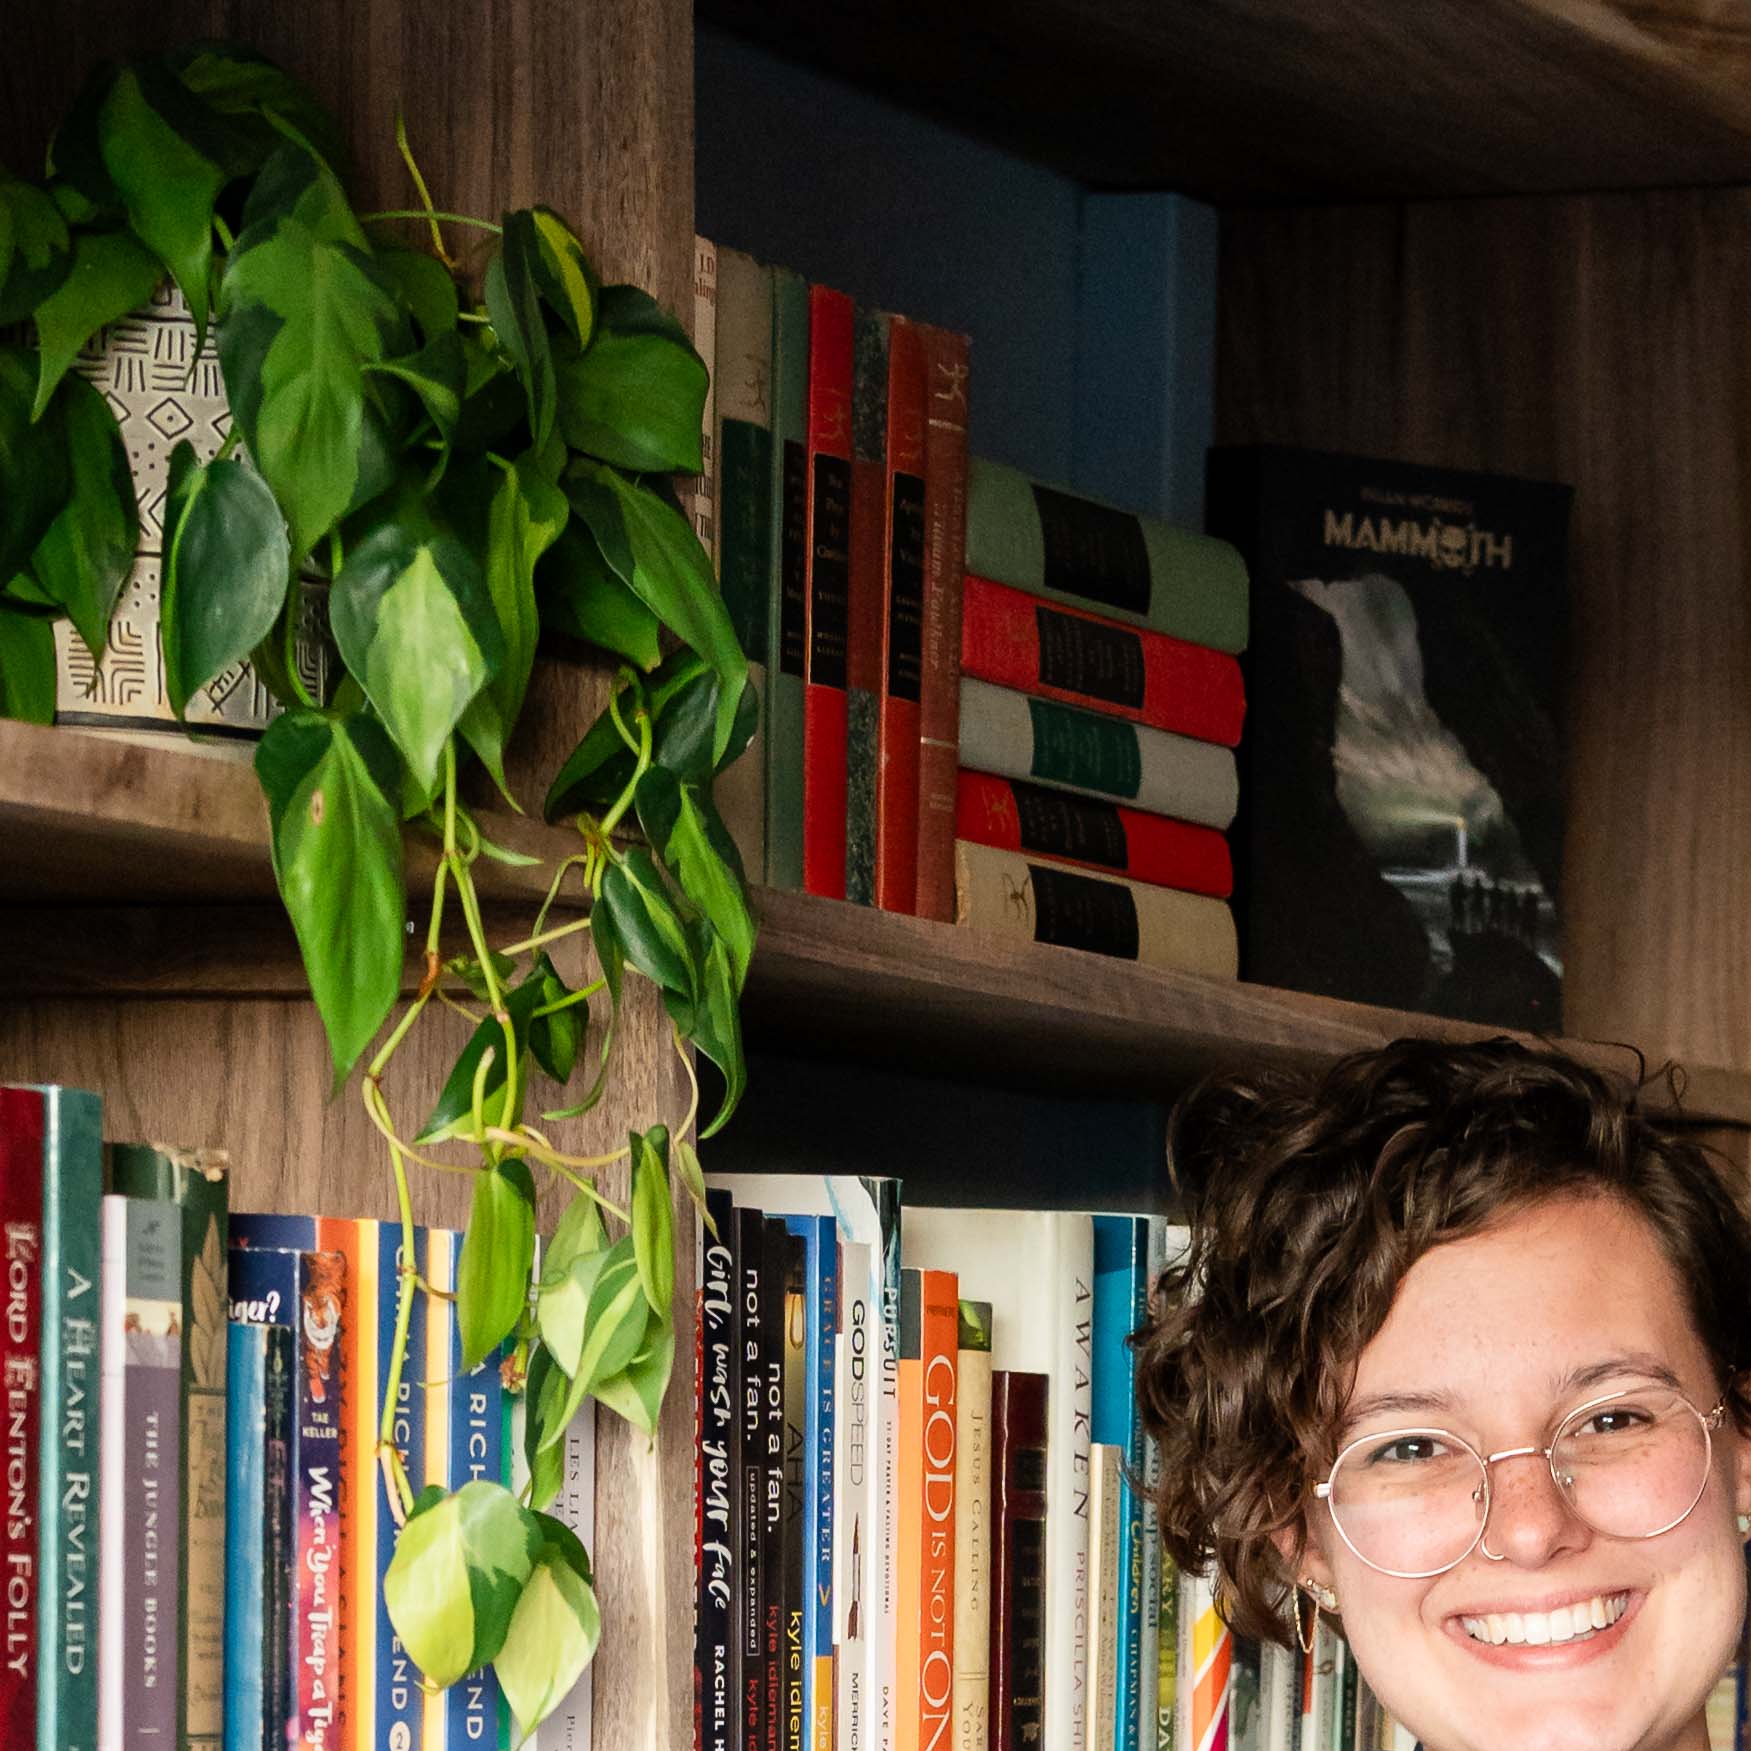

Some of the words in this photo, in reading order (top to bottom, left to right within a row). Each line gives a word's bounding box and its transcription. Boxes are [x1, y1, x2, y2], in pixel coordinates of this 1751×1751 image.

[5, 1221, 37, 1344] LORD
[66, 1267, 92, 1300] A
[704, 1245, 733, 1330] Girl,
[61, 1315, 92, 1458] HEART
[711, 1343, 732, 1428] wash
[882, 1287, 898, 1399] PURSUIT
[302, 1426, 338, 1440] KELLER
[311, 1412, 329, 1425] TAE
[850, 1299, 866, 1486] GODSPEED
[924, 1354, 955, 1522] GOD
[1072, 1277, 1092, 1517] AWAKEN
[5, 1352, 34, 1540] FENTON'S
[144, 1411, 160, 1469] THE
[970, 1411, 982, 1485] JESUS
[142, 1477, 160, 1587] JUNGLE
[703, 1440, 730, 1533] your
[61, 1471, 90, 1676] REVEALED
[702, 1539, 732, 1611] face
[931, 1531, 945, 1557] IS
[969, 1499, 981, 1612] CALLING
[7, 1553, 33, 1680] FOLLY
[142, 1597, 159, 1689] BOOKS
[787, 1610, 803, 1671] kyle
[930, 1569, 946, 1647] NOT
[1072, 1551, 1084, 1691] PRISCILLA
[713, 1645, 725, 1731] RACHEL
[816, 1705, 829, 1748] kyle
